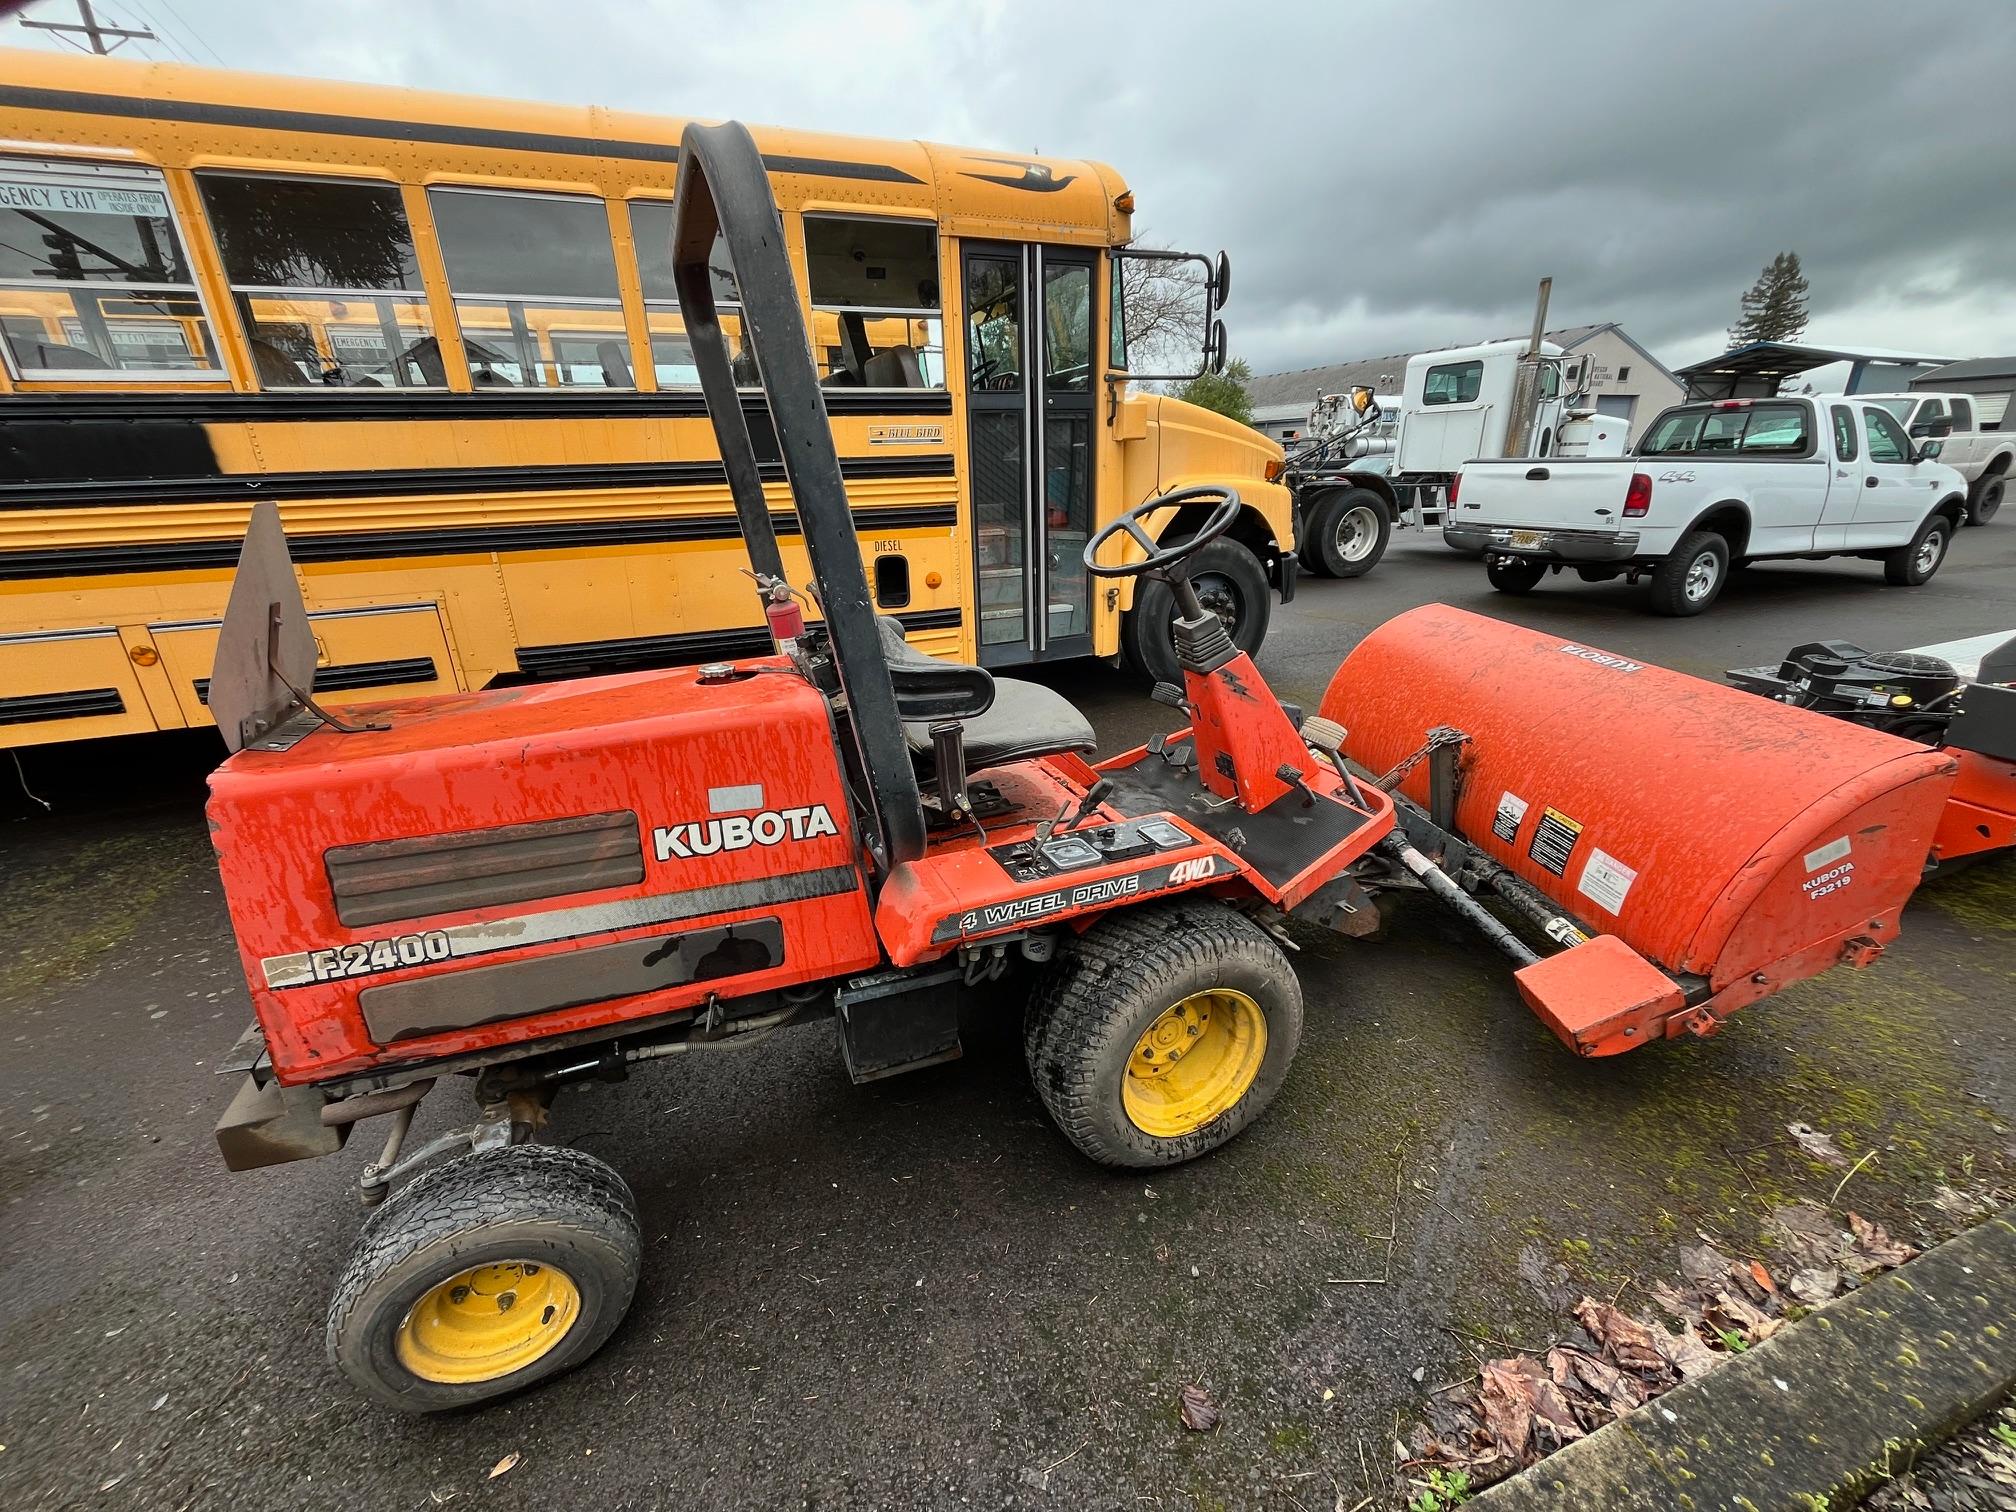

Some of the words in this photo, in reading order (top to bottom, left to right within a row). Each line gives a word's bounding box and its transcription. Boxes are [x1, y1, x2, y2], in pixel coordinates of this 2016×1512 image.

[61, 190, 97, 209] EXIT
[97, 191, 138, 202] OPERATES
[138, 193, 162, 203] FROM
[109, 202, 136, 213] INSIDE
[137, 203, 156, 214] ONLY
[336, 337, 378, 347] EMERGENCY
[888, 427, 912, 438] BLUE
[916, 427, 940, 438] BIRD
[875, 540, 903, 551] DIESEL
[1560, 645, 1645, 673] KUBOTA
[652, 804, 838, 861] KUBOTA
[1169, 855, 1216, 884] 4WD
[1802, 862, 1855, 891] KUBOTA
[1810, 876, 1852, 900] F3219
[959, 912, 977, 930] 4
[985, 893, 1066, 925] WHEEL
[1072, 875, 1139, 905] DRIVE
[309, 930, 451, 980] F2400
